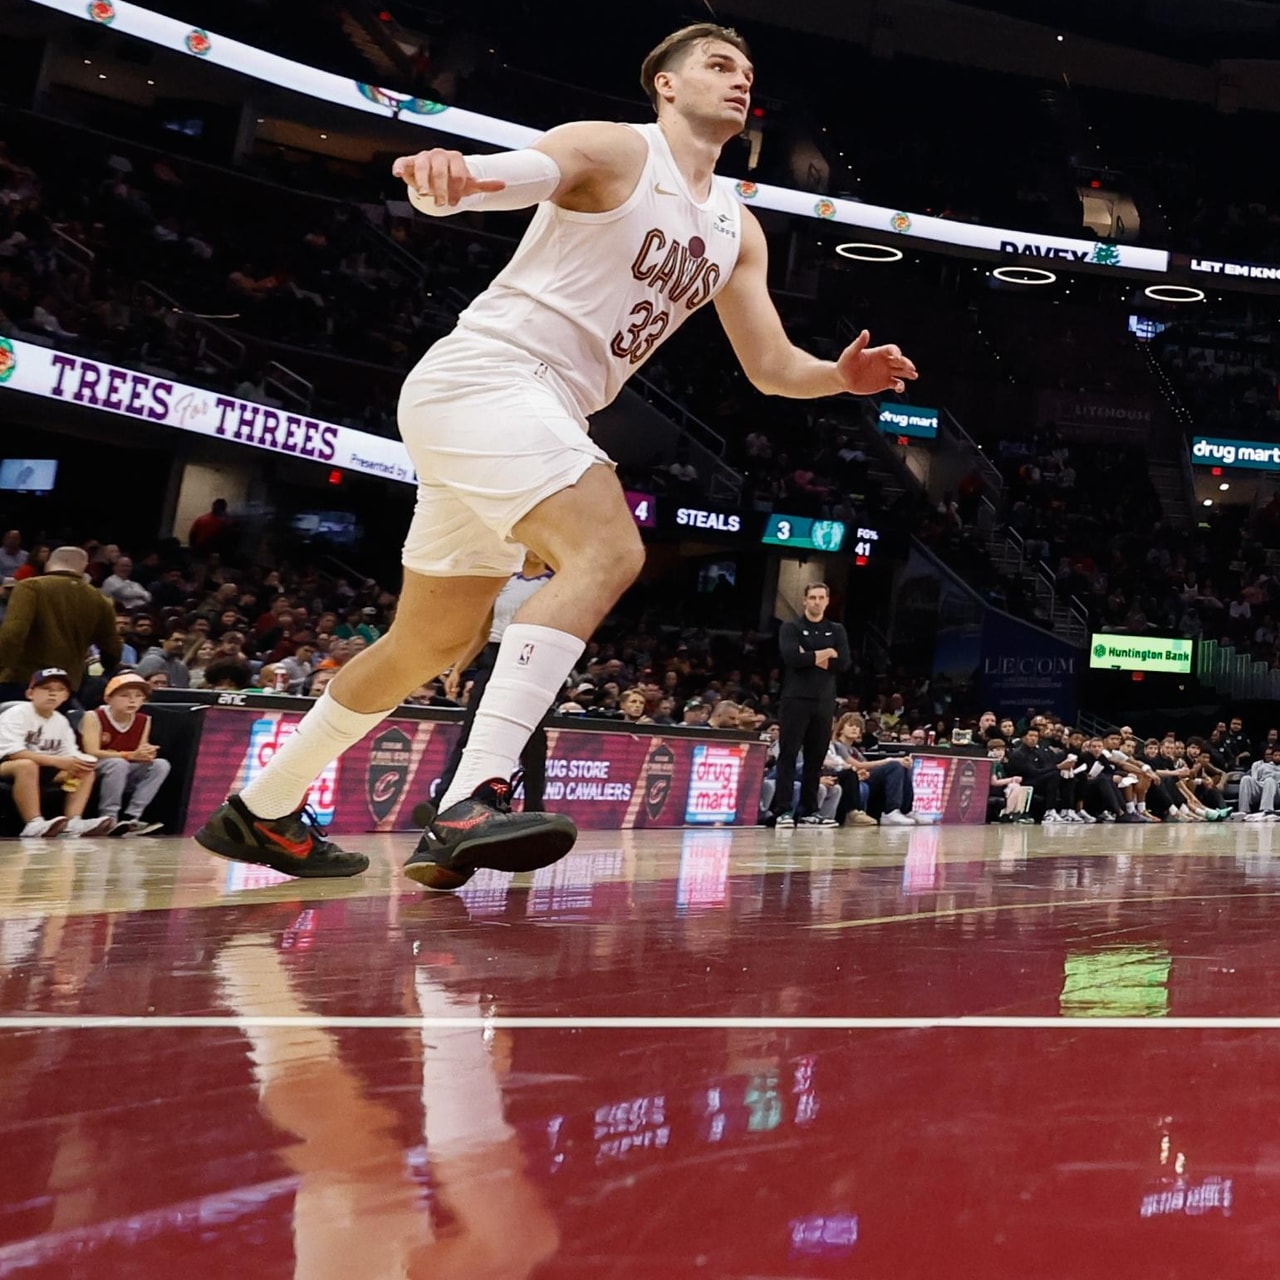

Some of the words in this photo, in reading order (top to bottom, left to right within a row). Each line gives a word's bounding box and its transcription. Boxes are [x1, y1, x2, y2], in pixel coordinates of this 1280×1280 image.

[631, 228, 720, 310] CAVS
[1191, 259, 1224, 273] LET
[1224, 262, 1249, 276] EM
[610, 300, 669, 364] 33
[51, 354, 174, 421] TREES
[214, 397, 339, 462] THREES
[349, 453, 395, 477] Presented
[879, 410, 907, 426] drug
[909, 415, 938, 429] mart
[1074, 403, 1152, 420] LITEHOUSE
[1193, 440, 1235, 463] drug
[1238, 445, 1280, 464] mart
[634, 500, 649, 521] 4
[676, 507, 740, 532] STEALS
[776, 521, 791, 540] 3
[857, 528, 879, 540] FG%
[855, 542, 870, 556] 41
[1108, 646, 1163, 662] Huntington
[1165, 650, 1190, 662] Bank
[569, 760, 609, 780] STORE
[697, 757, 733, 787] drug
[566, 781, 632, 801] CAVALIERS
[695, 788, 738, 810] mart
